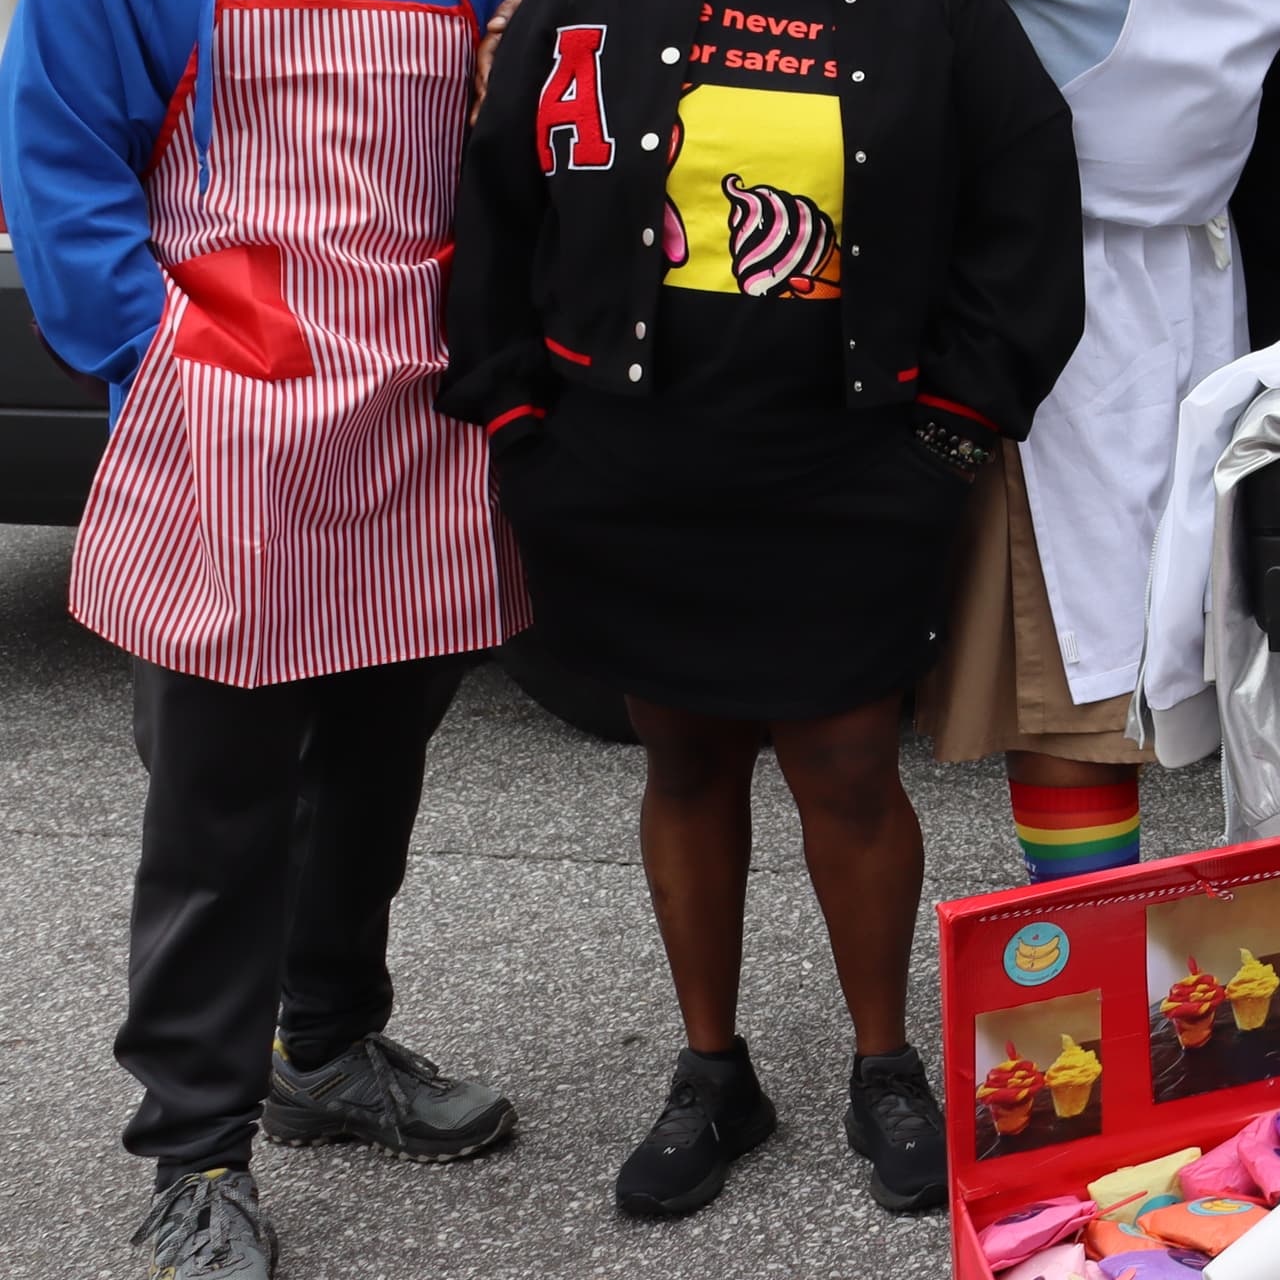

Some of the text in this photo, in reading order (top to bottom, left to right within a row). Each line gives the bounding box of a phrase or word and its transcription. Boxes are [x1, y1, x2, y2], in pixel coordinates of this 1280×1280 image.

[722, 7, 824, 41] never
[725, 48, 816, 76] safer
[536, 24, 616, 177] A
